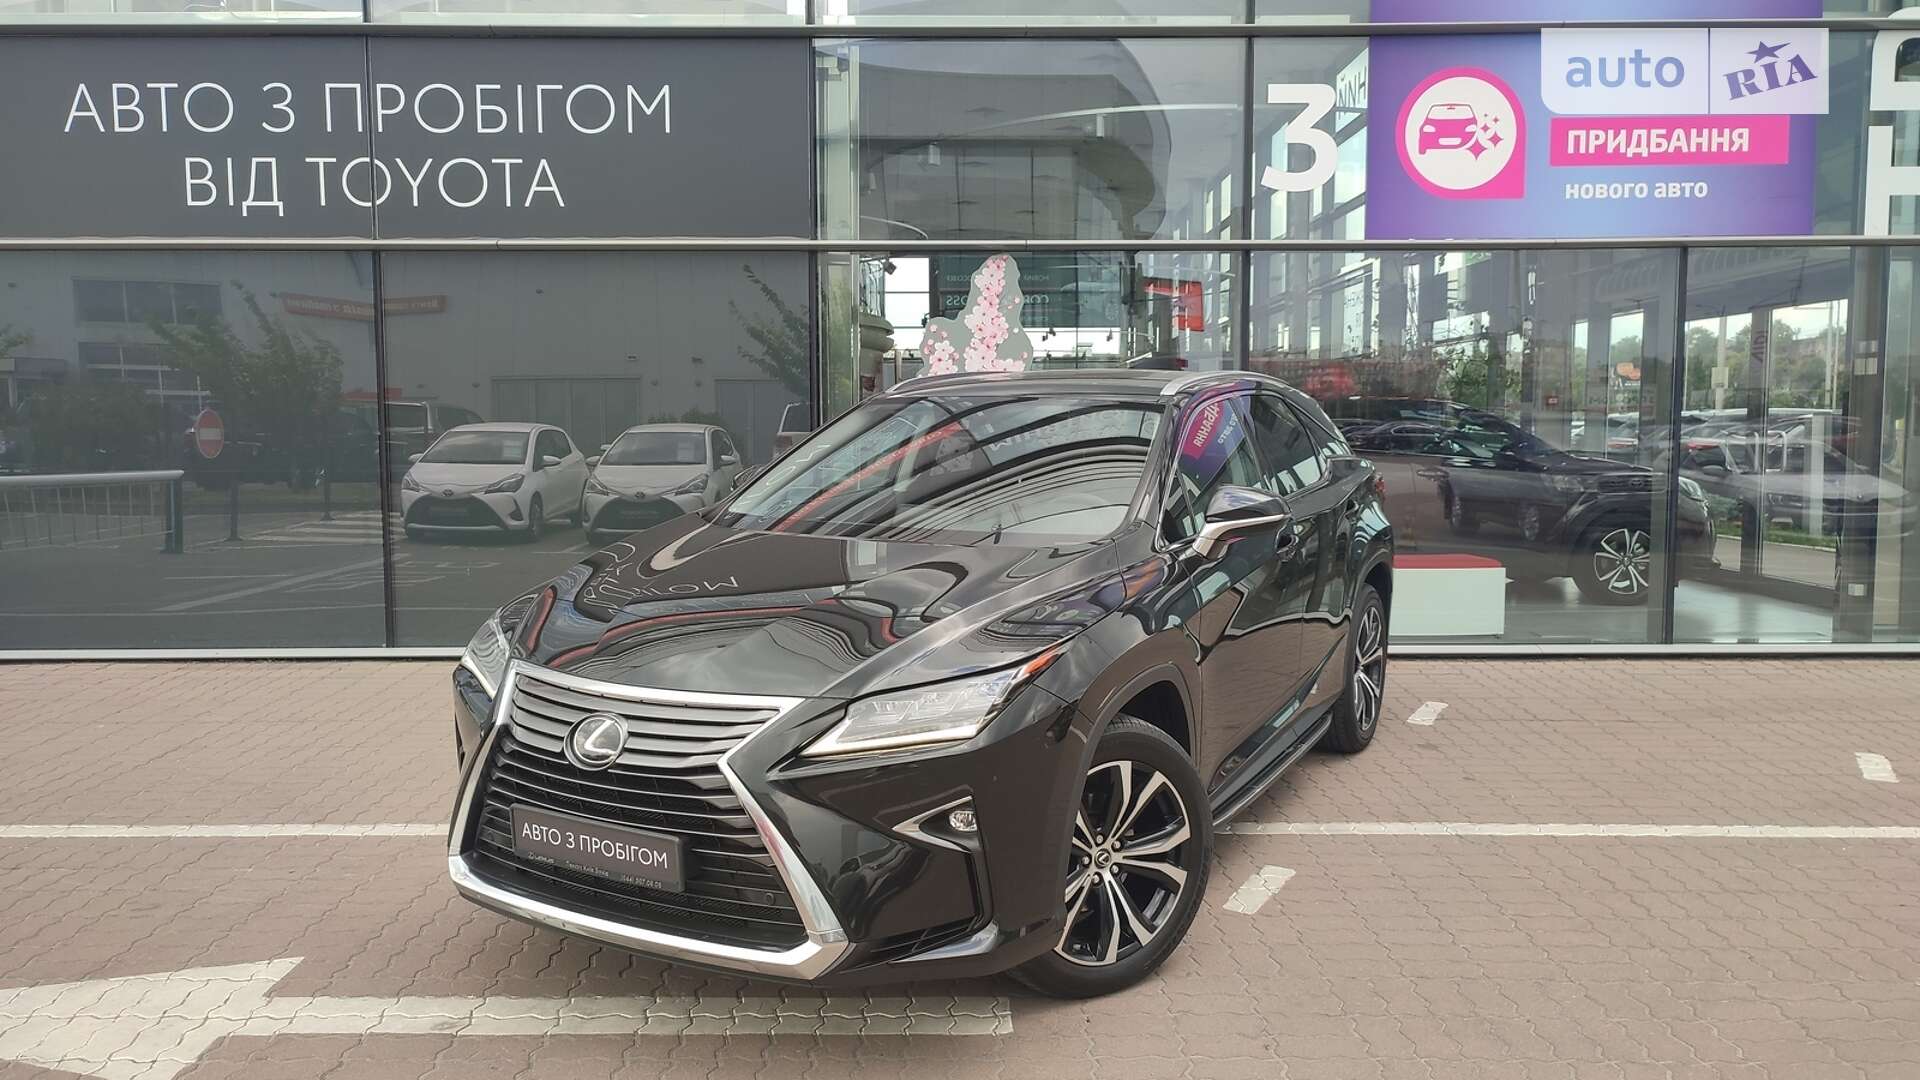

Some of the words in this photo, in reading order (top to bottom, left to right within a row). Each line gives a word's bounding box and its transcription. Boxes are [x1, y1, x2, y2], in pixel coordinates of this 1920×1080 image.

[64, 82, 234, 133] АВТО
[324, 82, 671, 135] ПРОБІГОМ
[1566, 127, 1750, 158] ПРИДБАННЯ
[184, 157, 284, 217] ВІД
[304, 157, 565, 208] TOYOTA
[1564, 181, 1649, 200] нового
[1653, 181, 1709, 199] авто
[522, 822, 562, 846] АВТО
[579, 834, 669, 870] ПРОБІГОМ
